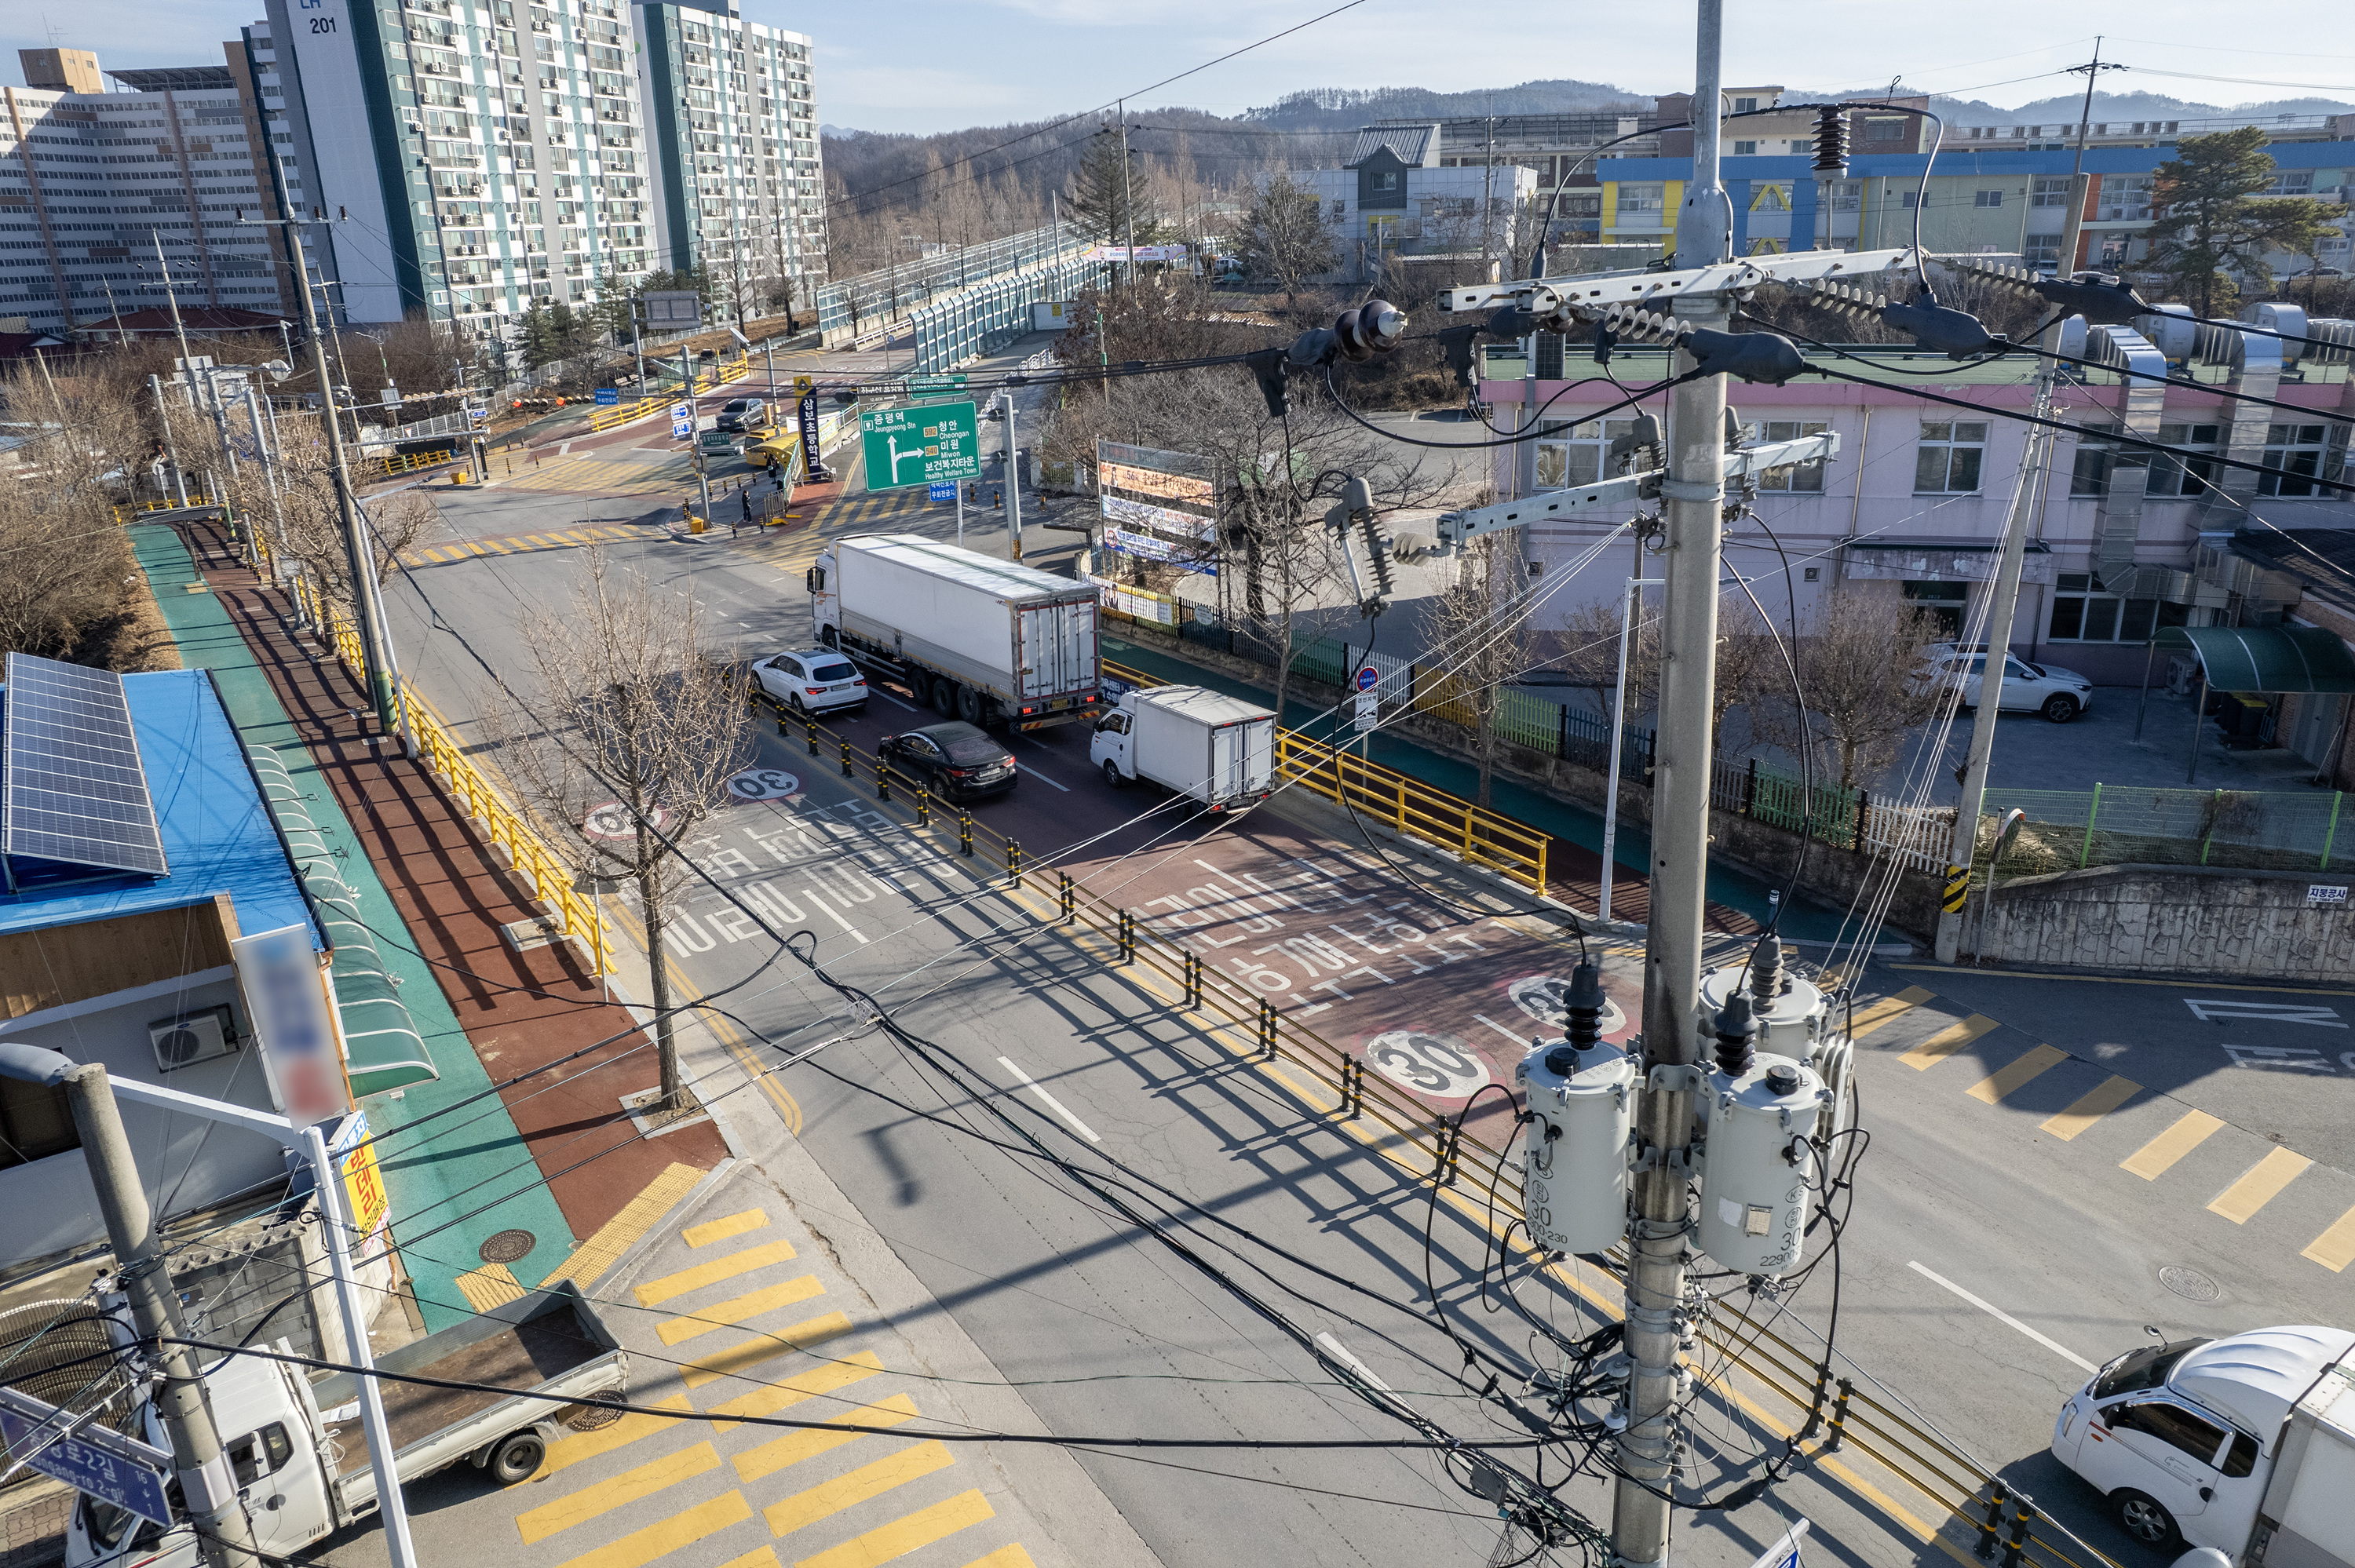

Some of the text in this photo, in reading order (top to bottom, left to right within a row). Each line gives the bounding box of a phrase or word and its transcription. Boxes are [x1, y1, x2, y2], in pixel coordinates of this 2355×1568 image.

[309, 16, 336, 34] 201
[874, 411, 904, 425] 증평역
[874, 423, 906, 433] Jeungpyeong
[938, 419, 957, 432] 청안
[803, 399, 820, 467] 삼보초등학교
[924, 428, 937, 436] 592
[939, 431, 969, 440] Cheongan
[940, 439, 959, 450] 미원
[926, 447, 938, 455] 540
[940, 450, 961, 459] Miwon
[925, 456, 975, 472] 보건복지타운
[925, 472, 943, 480] Healthy
[931, 490, 955, 498] 우회전금지
[734, 771, 793, 797] 30
[2309, 888, 2346, 899] 지붕공사
[1377, 1036, 1479, 1092] 30
[1532, 1199, 1551, 1226] 30
[1780, 1227, 1801, 1251] 30
[135, 1471, 148, 1484] 16
[147, 1503, 154, 1515] 1
